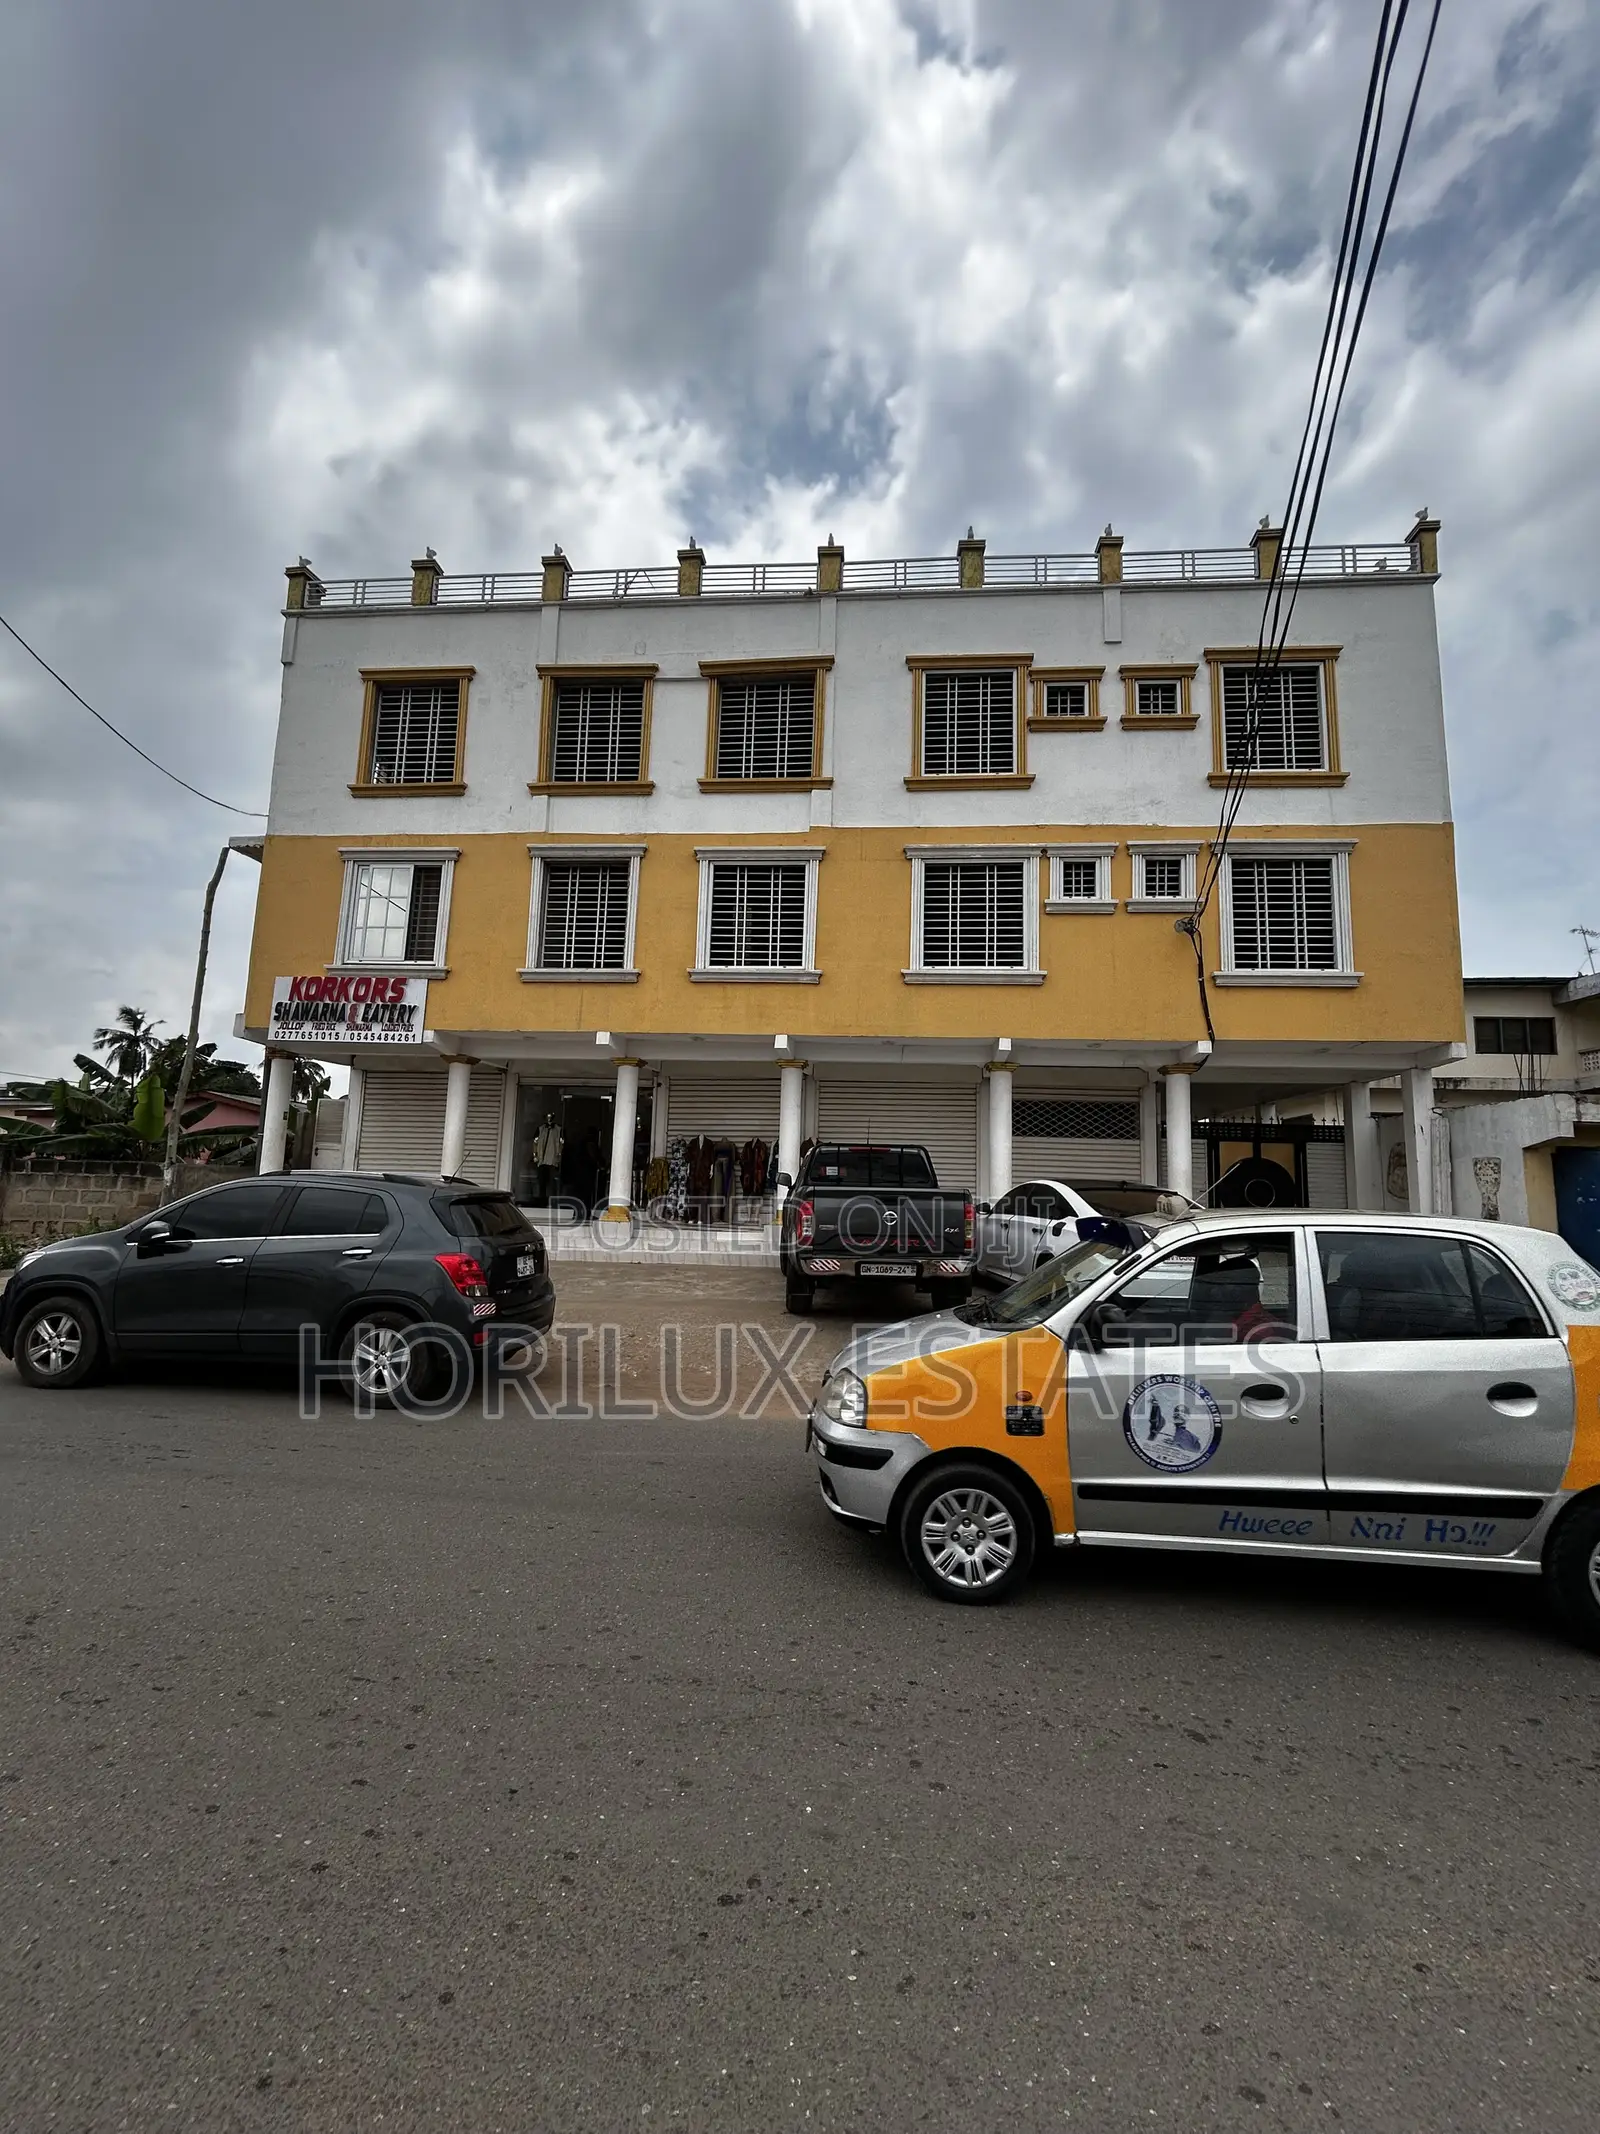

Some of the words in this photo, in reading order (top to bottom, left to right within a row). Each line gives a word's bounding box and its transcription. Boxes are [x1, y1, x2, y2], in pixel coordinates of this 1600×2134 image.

[288, 976, 407, 1003] KORKORS
[277, 1021, 305, 1031] JOLLOF
[361, 1003, 418, 1024] EATERY
[1127, 1375, 1162, 1405] BELIEVERS
[1164, 1375, 1205, 1395] WORSHIP
[1203, 1395, 1222, 1428] CENTRE
[1350, 1516, 1407, 1542] Nni
